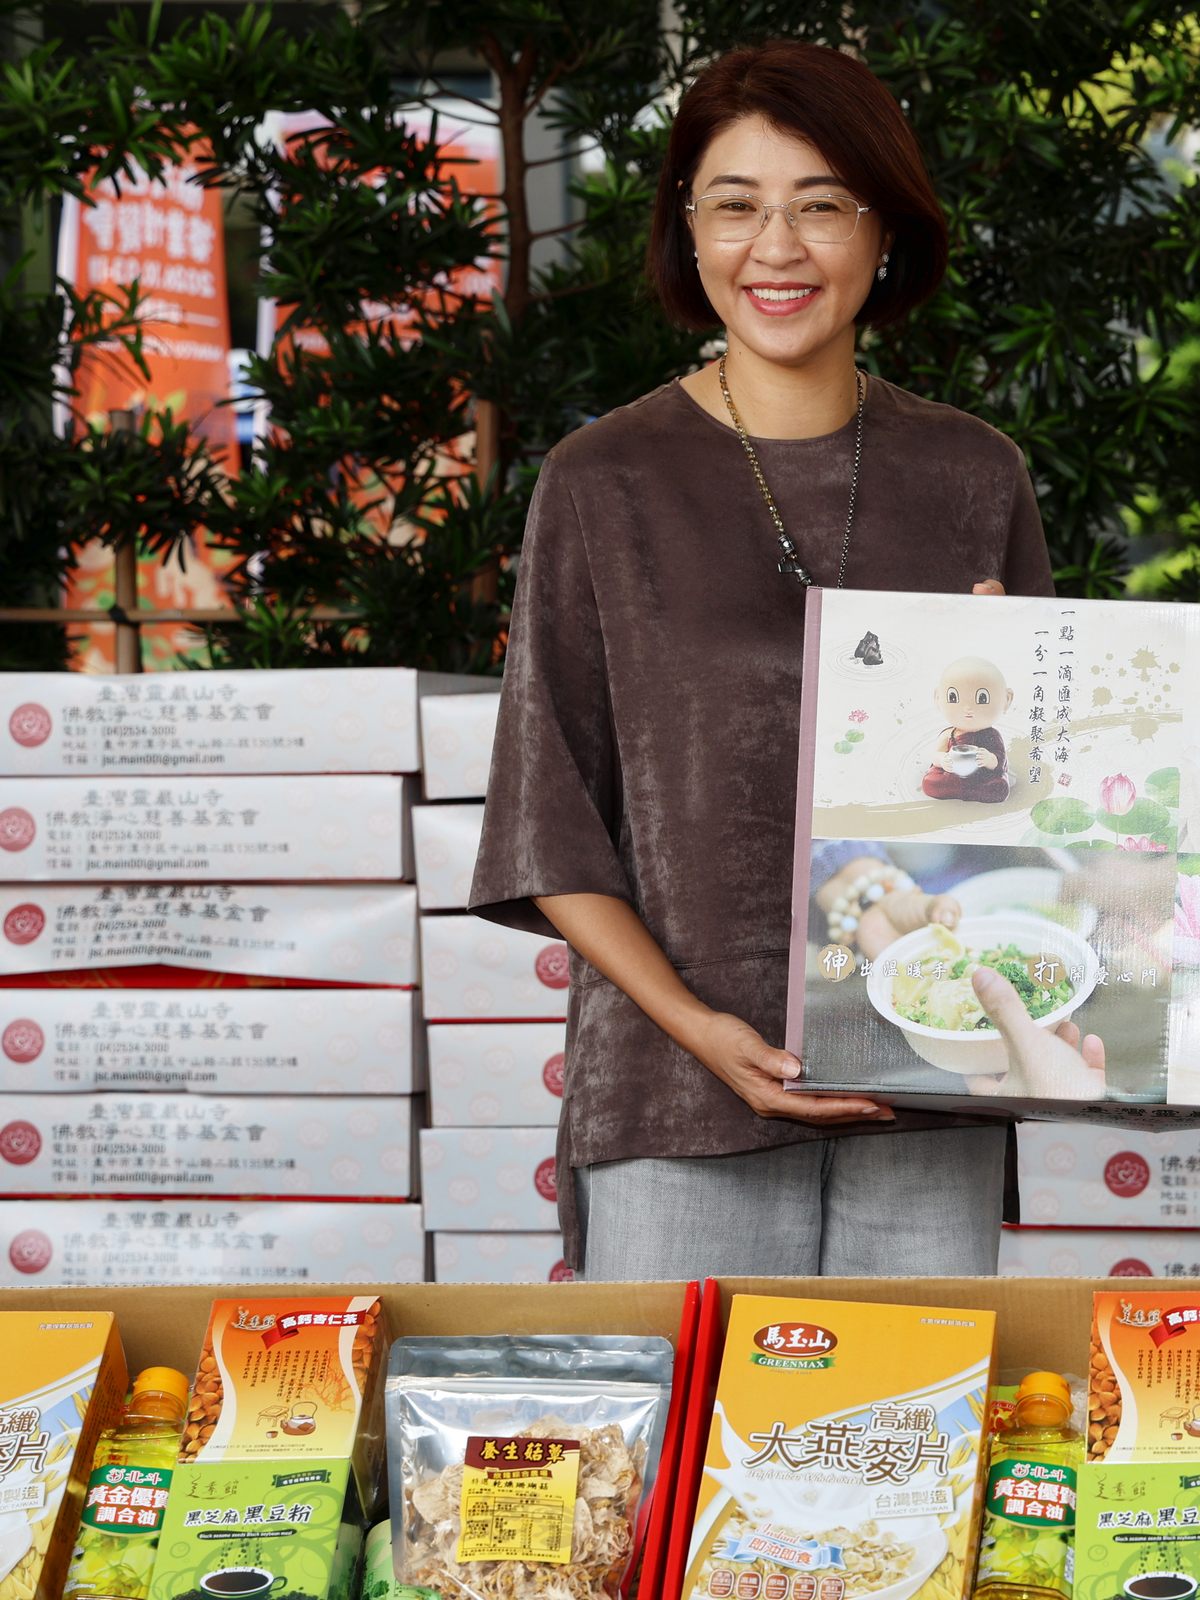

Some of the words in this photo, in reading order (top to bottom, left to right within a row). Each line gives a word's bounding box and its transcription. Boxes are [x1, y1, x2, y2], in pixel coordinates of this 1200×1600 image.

[1054, 609, 1076, 763] 一點一滴匯成大海
[1028, 630, 1049, 784] 一分一角凝聚希望
[280, 1313, 358, 1329] 高鈣杏仁茶
[762, 1325, 831, 1349] 馬玉山
[758, 1356, 826, 1369] GREENMAX
[871, 1404, 934, 1433] 高纖
[744, 1420, 950, 1484] 大燕麥片
[125, 1470, 162, 1485] 北斗
[1030, 1466, 1067, 1482] 北斗
[993, 1479, 1076, 1510] 黃金優質
[96, 1506, 157, 1526] 調合油
[1005, 1498, 1065, 1521] 調合油
